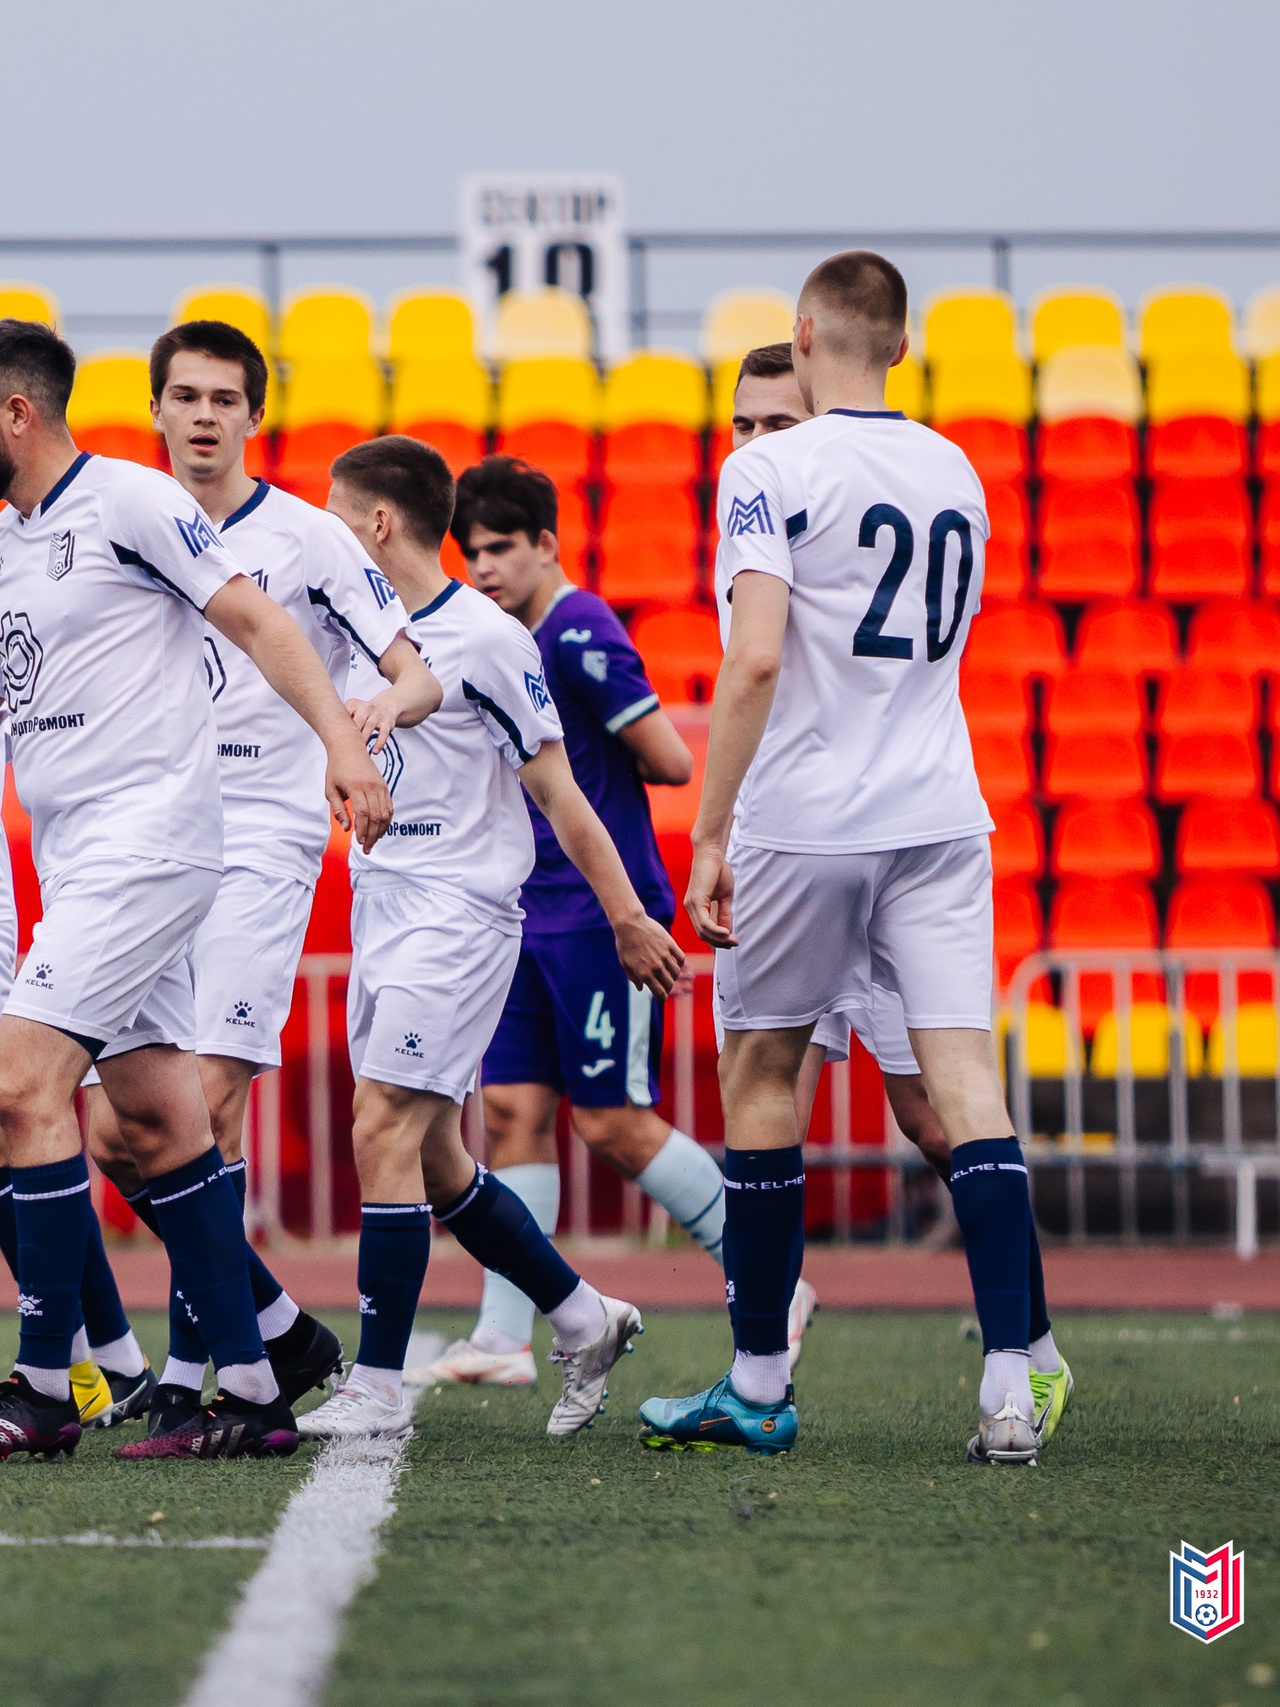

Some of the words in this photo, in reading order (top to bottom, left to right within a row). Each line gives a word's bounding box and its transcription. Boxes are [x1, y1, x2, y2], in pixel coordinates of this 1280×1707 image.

[852, 503, 973, 663] 20
[217, 743, 261, 758] монт
[25, 979, 55, 990] KELME
[225, 1017, 256, 1028] KELME
[584, 991, 616, 1049] 4
[395, 1047, 425, 1059] KELME
[745, 1175, 803, 1190] KELME
